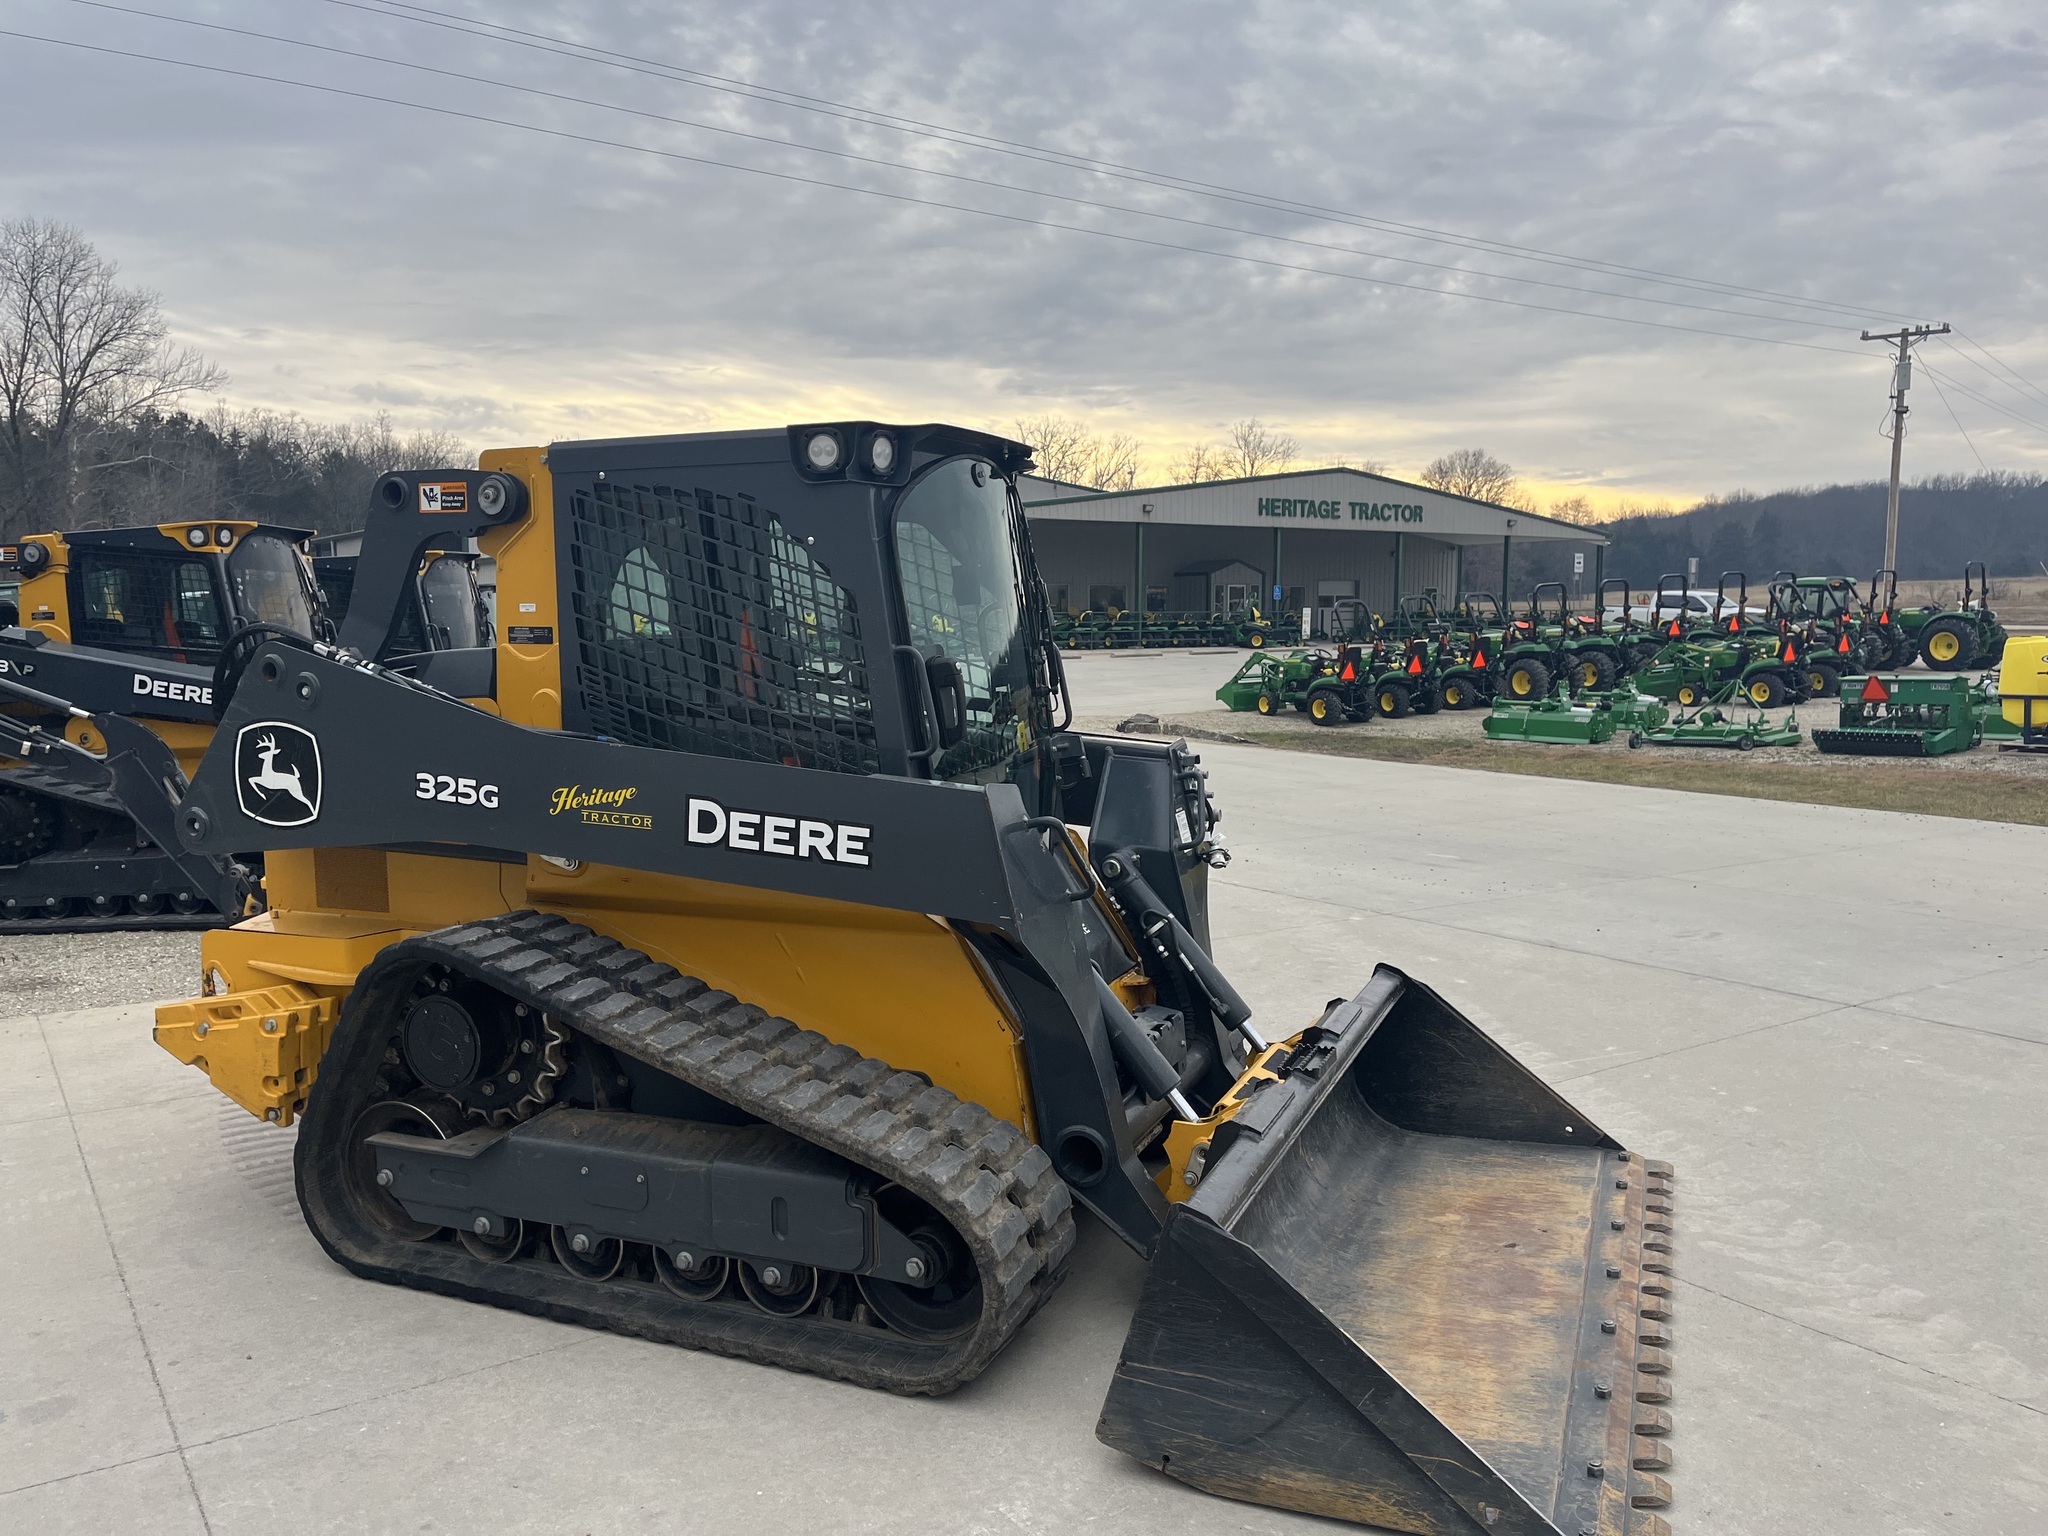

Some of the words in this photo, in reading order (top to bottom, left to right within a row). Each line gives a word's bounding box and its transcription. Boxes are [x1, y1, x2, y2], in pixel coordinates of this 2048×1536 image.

[1258, 497, 1341, 519] HERITAGE
[1349, 501, 1423, 522] TRACTOR
[133, 673, 213, 705] DEERE
[416, 772, 499, 808] 325G
[549, 784, 637, 816] Heritage
[581, 811, 652, 827] TRACTOR
[687, 798, 870, 866] DEERE
